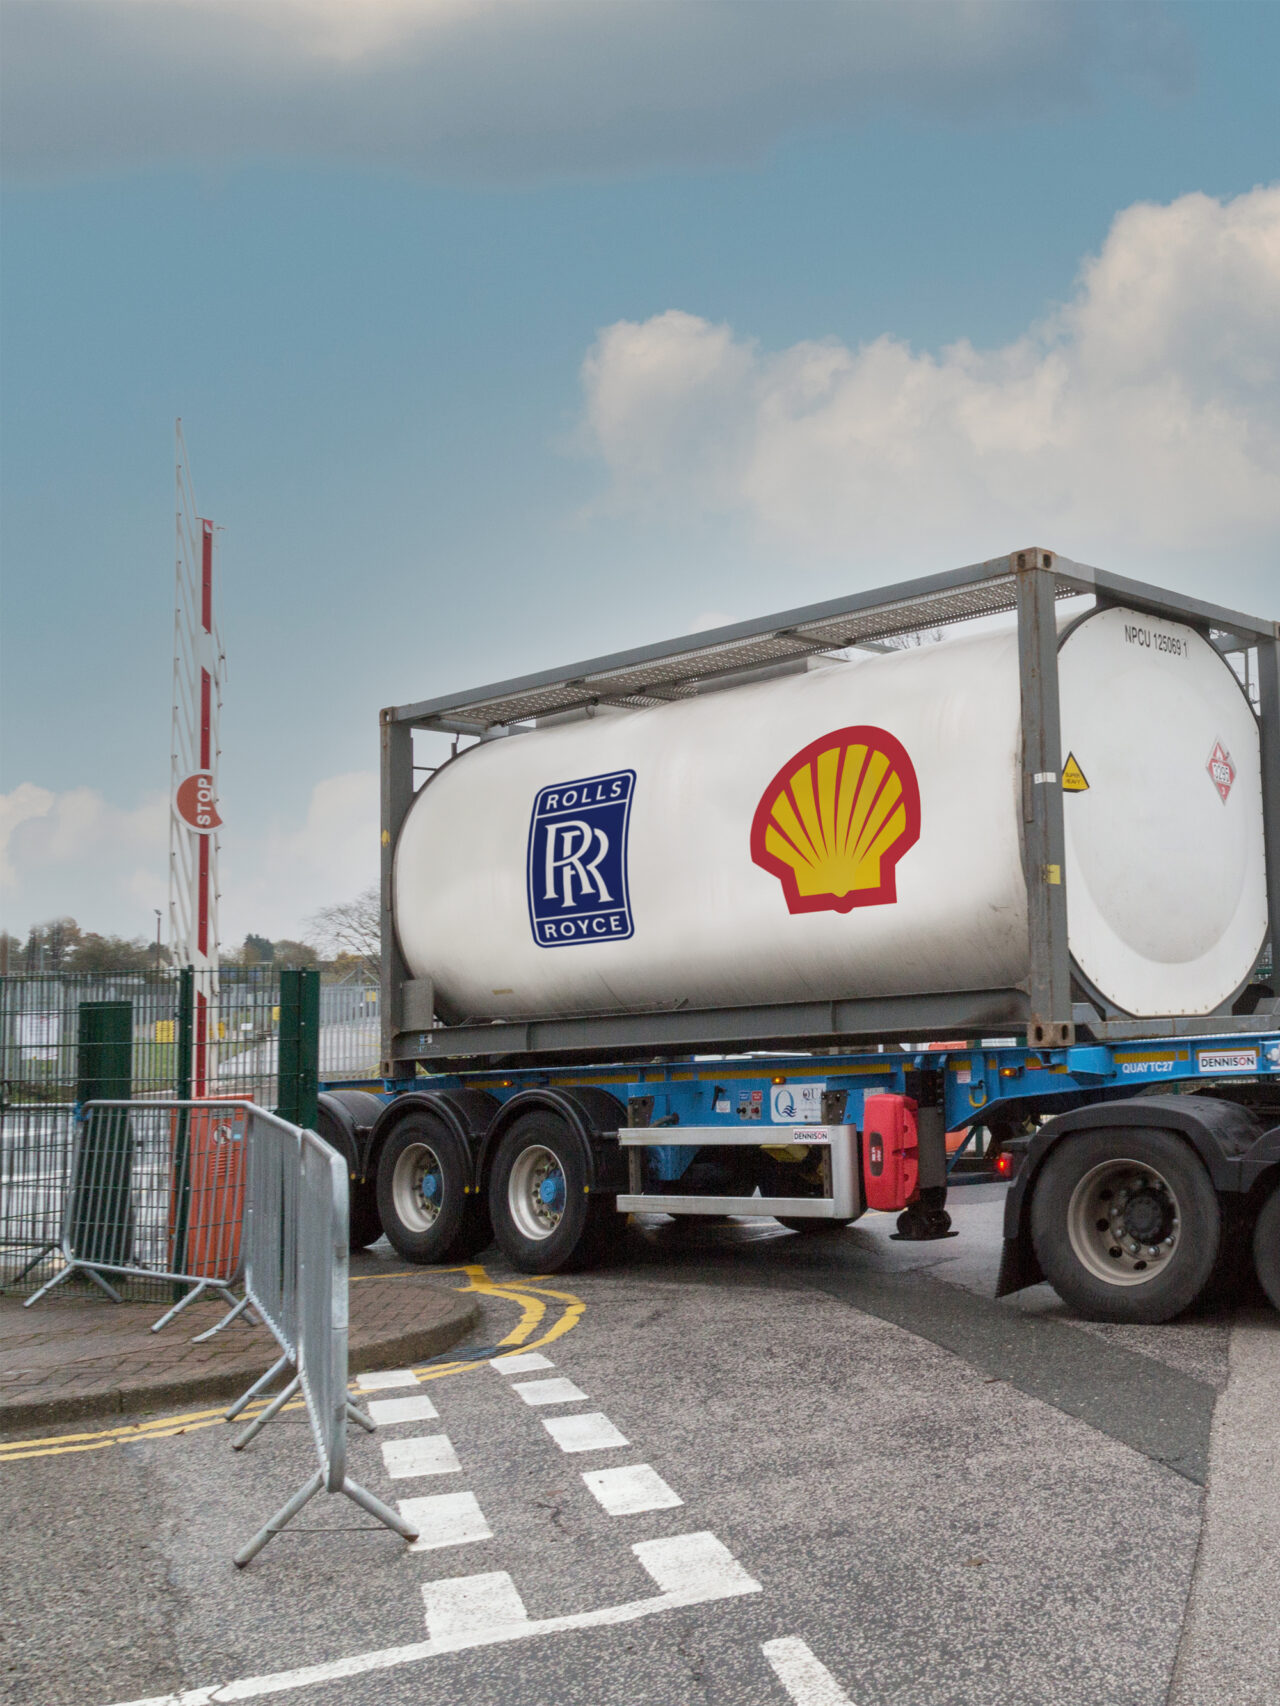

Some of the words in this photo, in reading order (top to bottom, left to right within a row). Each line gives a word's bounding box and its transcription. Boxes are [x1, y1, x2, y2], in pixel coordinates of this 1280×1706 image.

[1124, 625, 1151, 648] NPCU
[1154, 633, 1181, 656] 125069
[1183, 640, 1188, 658] 1
[197, 778, 212, 825] STOP
[546, 781, 622, 810] ROLLS
[544, 915, 622, 938] ROYCE
[1201, 1056, 1255, 1067] DENNISON
